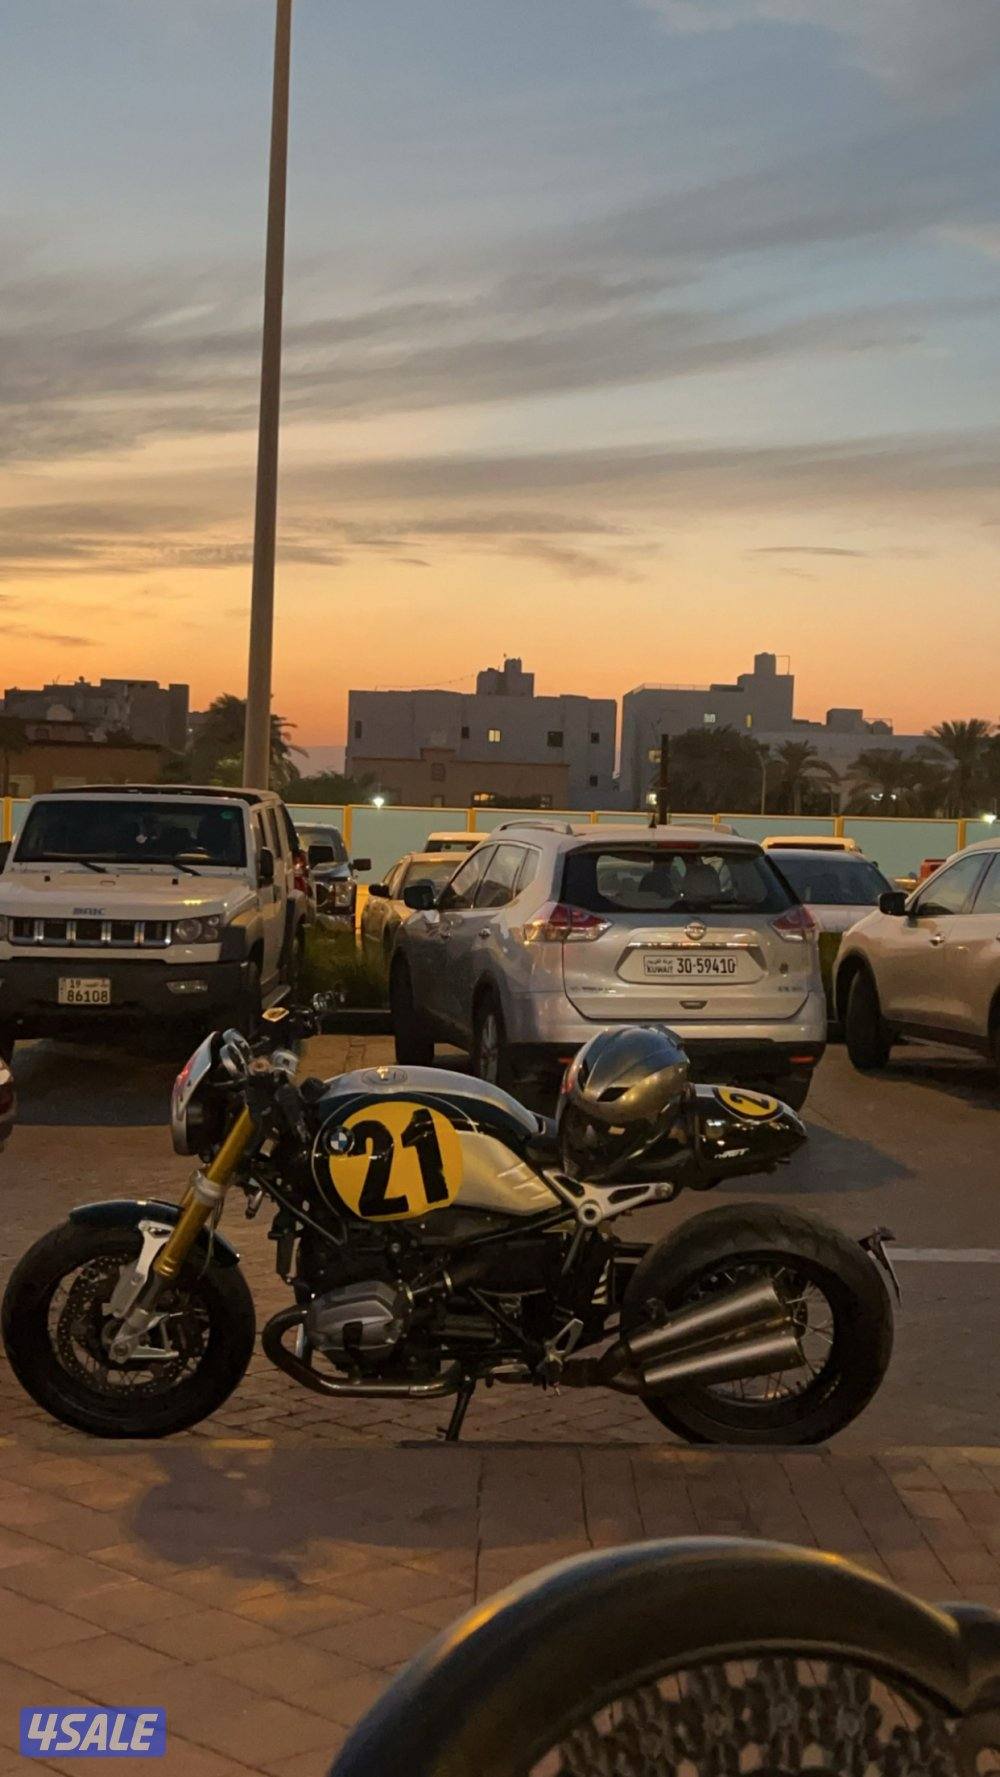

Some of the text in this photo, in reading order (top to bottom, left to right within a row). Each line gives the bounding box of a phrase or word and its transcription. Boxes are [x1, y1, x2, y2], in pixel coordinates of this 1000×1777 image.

[677, 957, 736, 974] 30-59410
[67, 989, 109, 1003] 86108
[345, 1108, 450, 1217] 21
